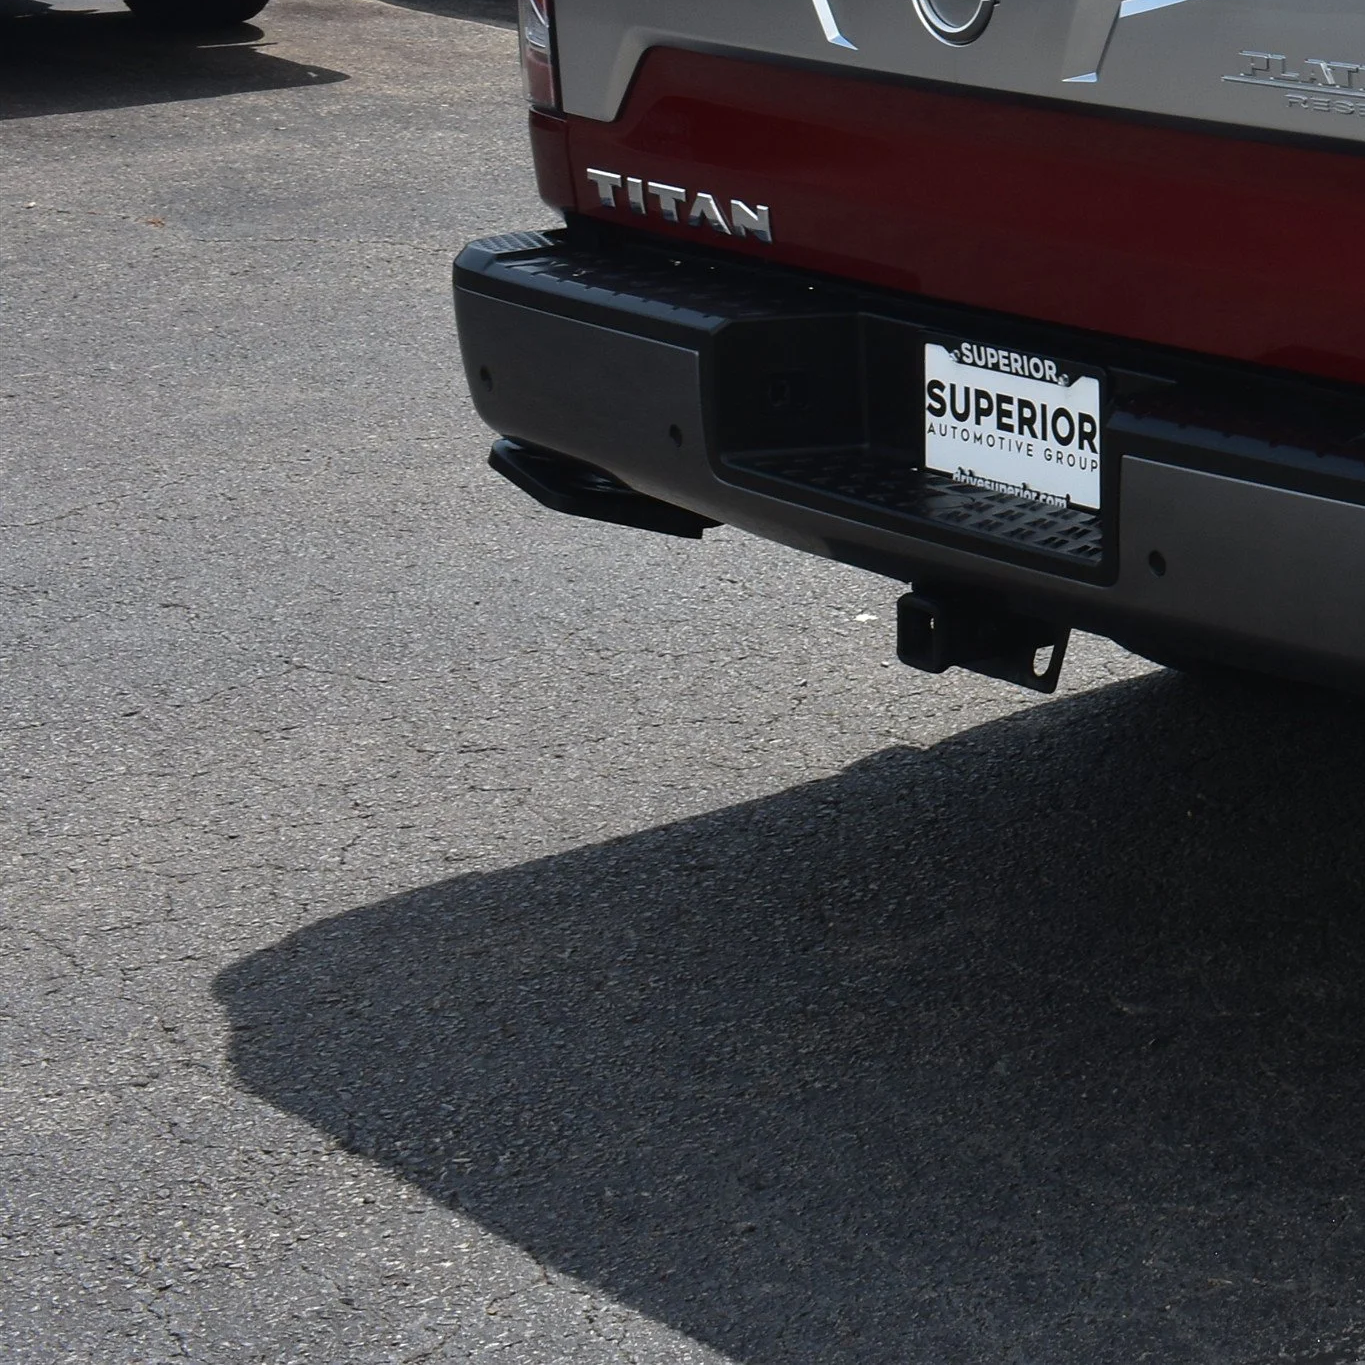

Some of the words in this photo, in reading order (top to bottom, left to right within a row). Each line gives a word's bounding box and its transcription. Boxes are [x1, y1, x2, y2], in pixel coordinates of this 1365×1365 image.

[585, 166, 774, 244] TITAN
[961, 341, 1059, 383] SUPERIOR
[926, 379, 1099, 455] SUPERIOR
[926, 422, 1034, 457] AUTOMOTIVE
[1043, 447, 1099, 473] GROUP
